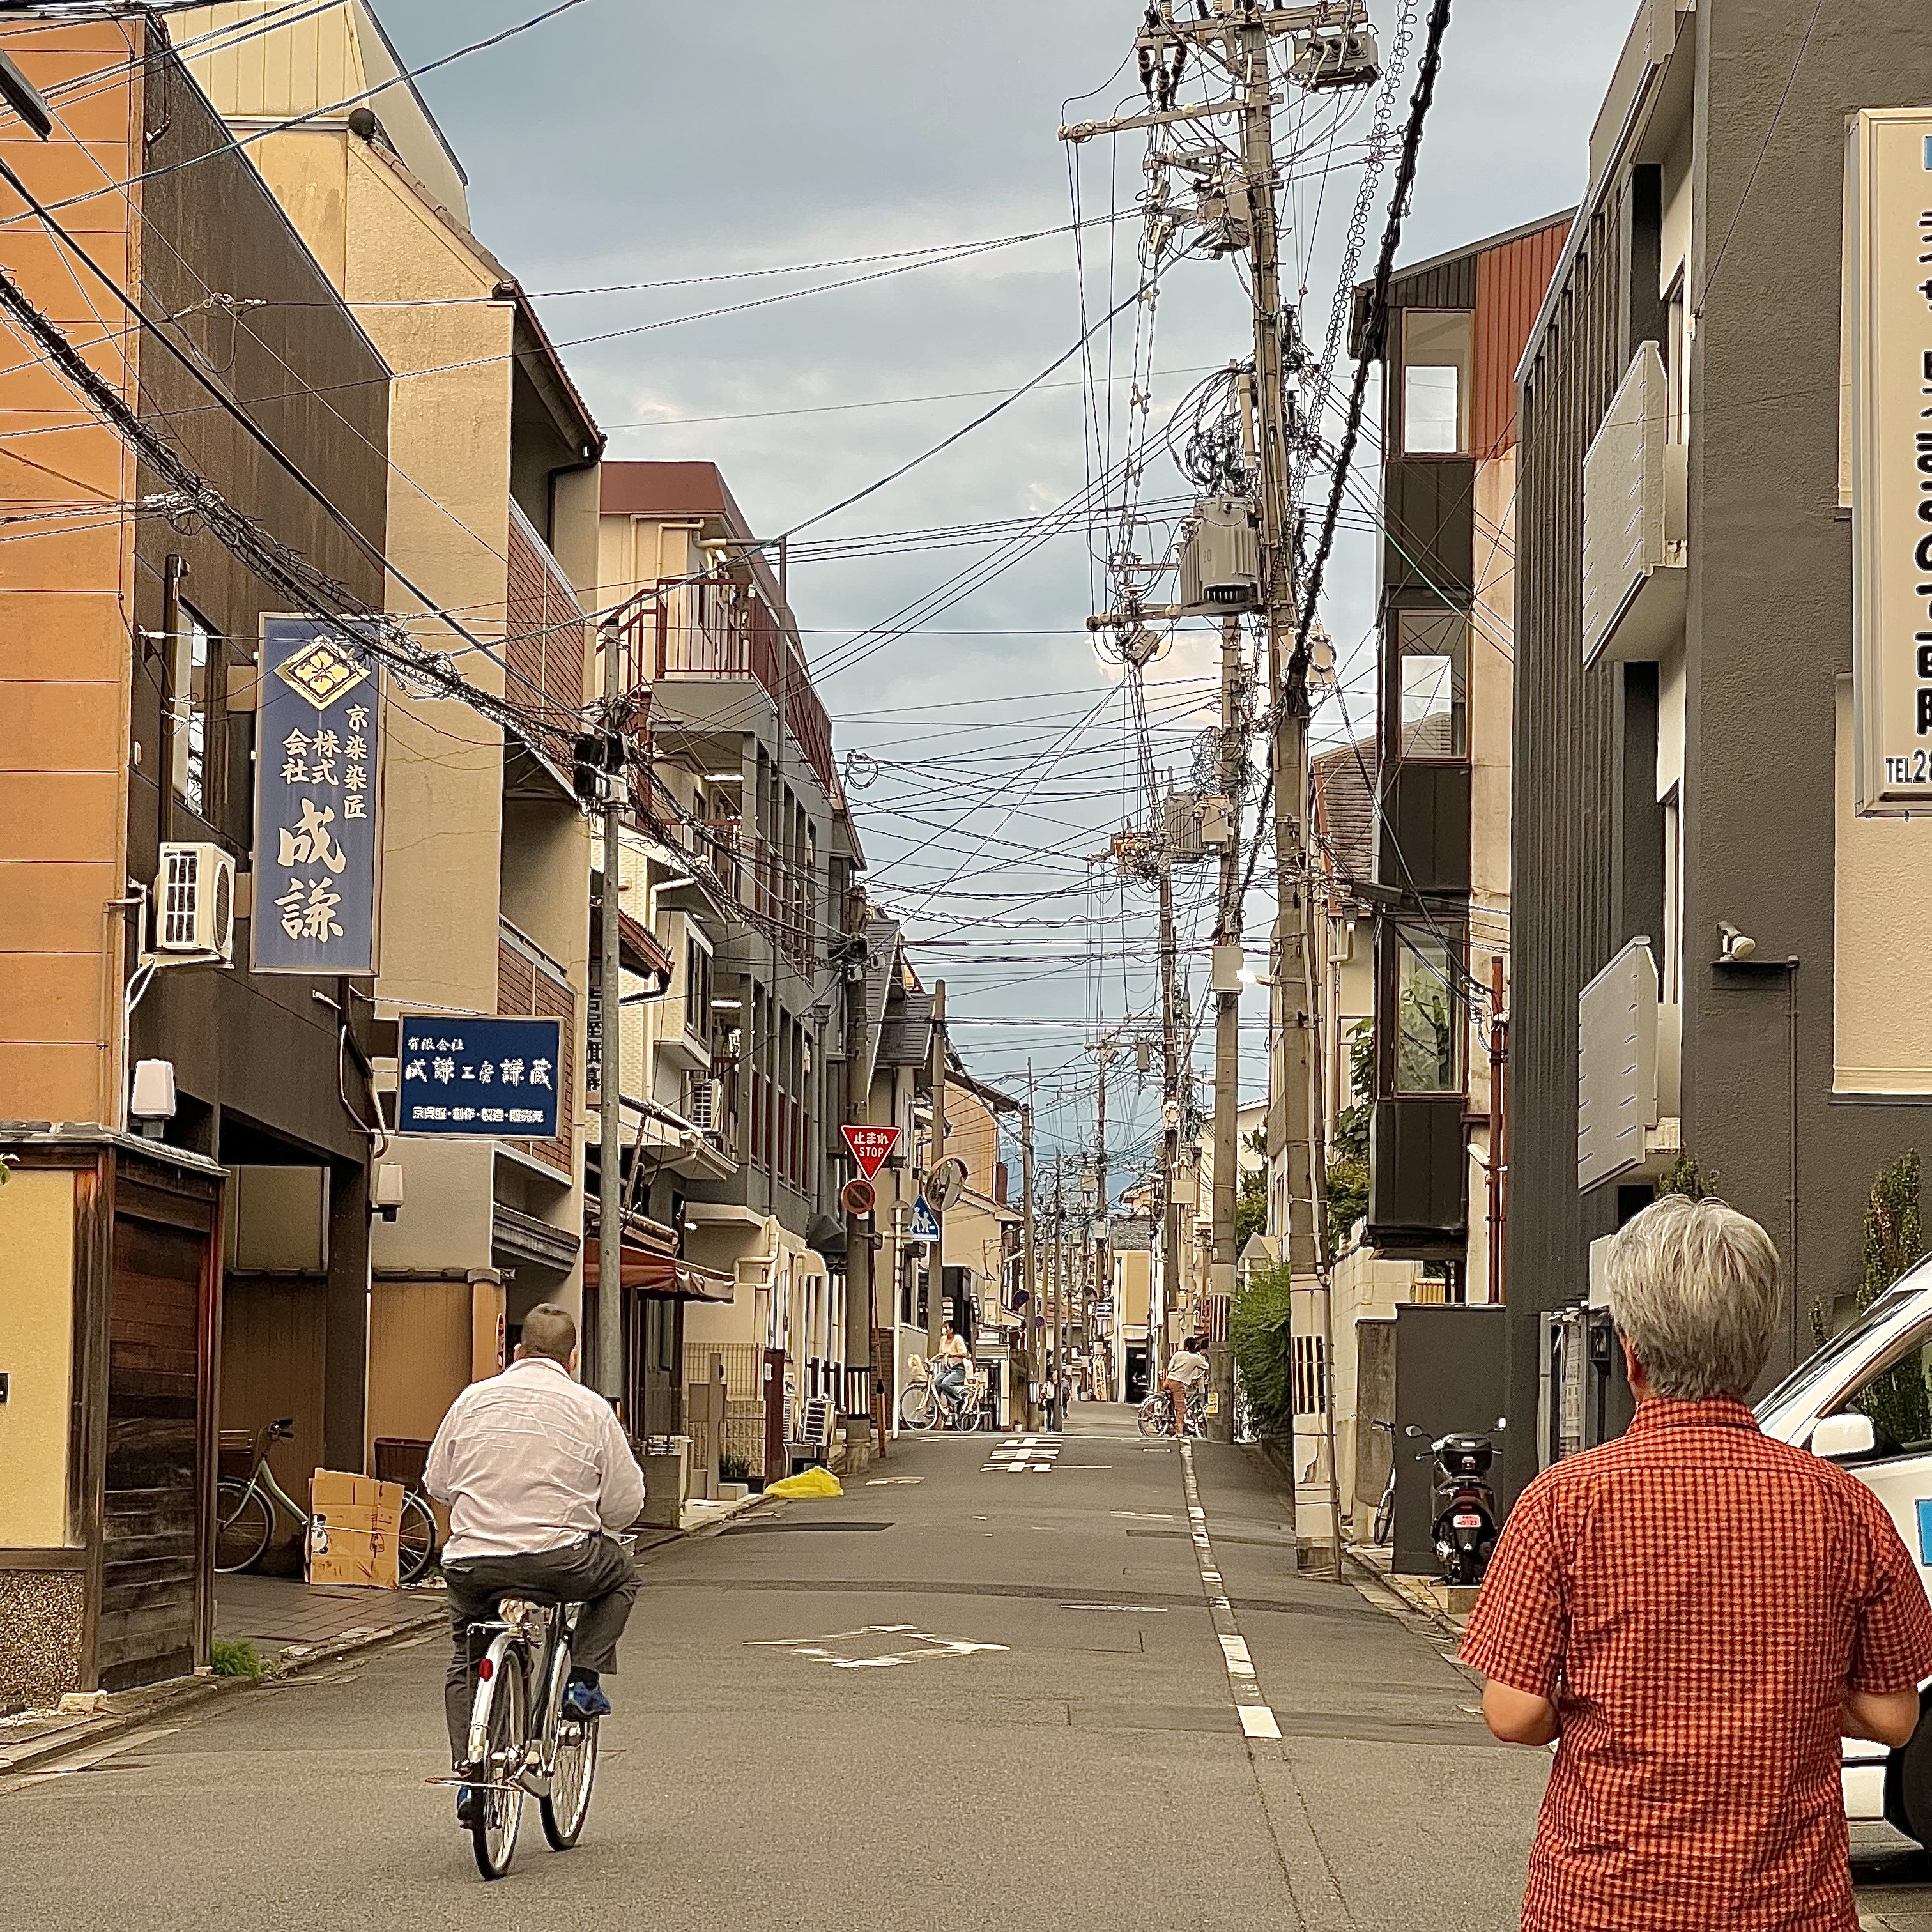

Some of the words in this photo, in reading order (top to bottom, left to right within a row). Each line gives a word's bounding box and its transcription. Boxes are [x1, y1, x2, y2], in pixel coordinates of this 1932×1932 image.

[343, 703, 369, 820] 京染染匠
[1885, 749, 1932, 783] TEL2
[273, 797, 346, 943] 成謙
[408, 1036, 464, 1052] 有限会社
[854, 1132, 889, 1144] 止まれ
[859, 1147, 884, 1157] STOP
